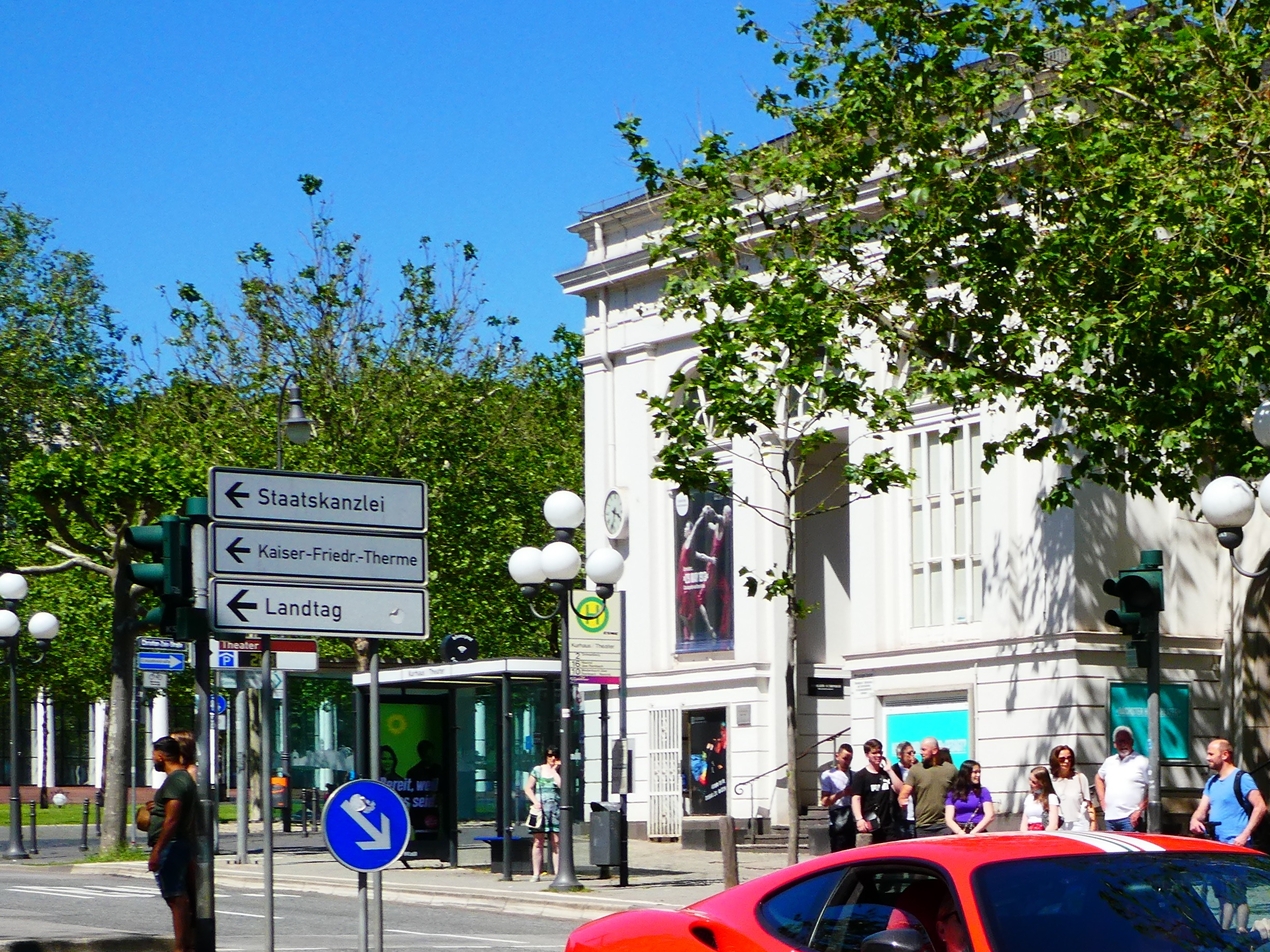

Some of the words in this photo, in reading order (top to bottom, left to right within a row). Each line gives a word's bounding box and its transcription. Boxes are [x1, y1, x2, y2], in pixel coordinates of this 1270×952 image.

[258, 488, 385, 513] Staatskanzlei
[258, 544, 418, 567] Kaiser-Friedr.-Therme
[265, 598, 342, 622] Landtag
[222, 640, 260, 650] Theater
